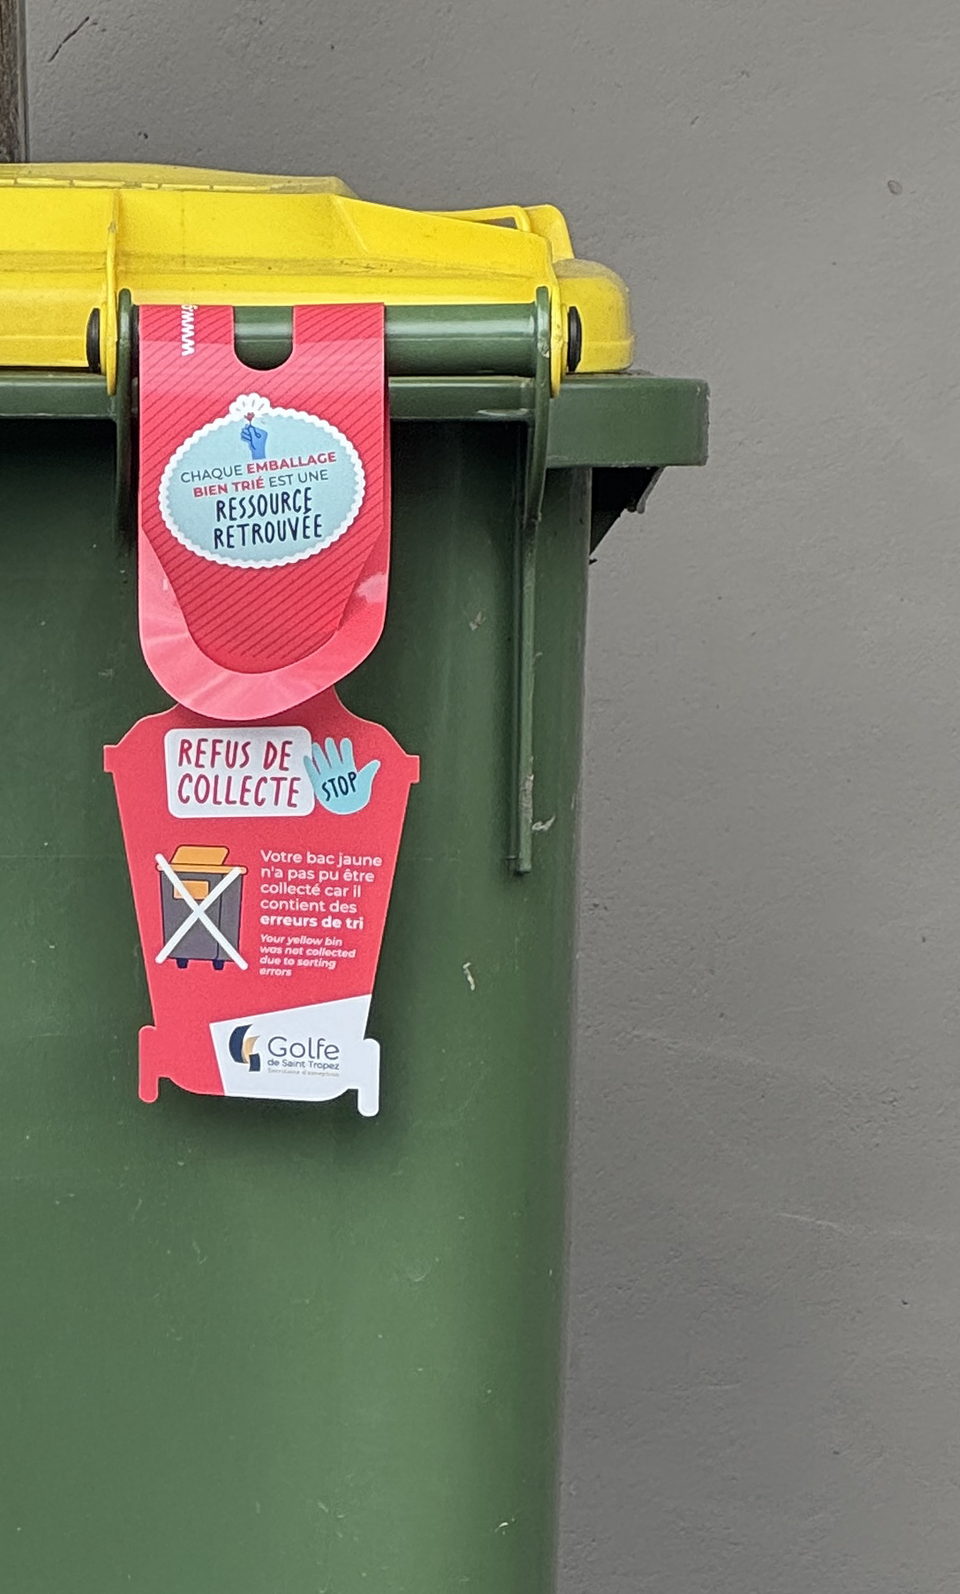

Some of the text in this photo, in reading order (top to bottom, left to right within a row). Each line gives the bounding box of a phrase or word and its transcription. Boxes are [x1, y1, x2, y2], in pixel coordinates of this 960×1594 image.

[181, 452, 337, 483] CHAQUE EMBALLAGE
[193, 469, 329, 498] BIEN TRIÉ EST UNE
[216, 487, 312, 522] RESSOURCE
[214, 511, 322, 550] RETROUVÉE
[178, 738, 293, 771] REFUS DE
[177, 773, 301, 808] COLLECTE
[321, 771, 357, 802] STOP
[260, 850, 382, 868] Votre bac jaune
[261, 866, 375, 883] n'a pas pu être
[260, 882, 361, 898] collecté car il
[260, 899, 357, 913] contient des
[260, 915, 364, 930] erreurs de tri
[261, 934, 343, 947] Your yellow bin
[260, 945, 356, 958] was not collected
[260, 955, 336, 970] due to sorting
[260, 968, 292, 977] errors
[268, 1036, 339, 1060] Golfe
[282, 1059, 305, 1067] Saint
[308, 1060, 339, 1070] Tropez
